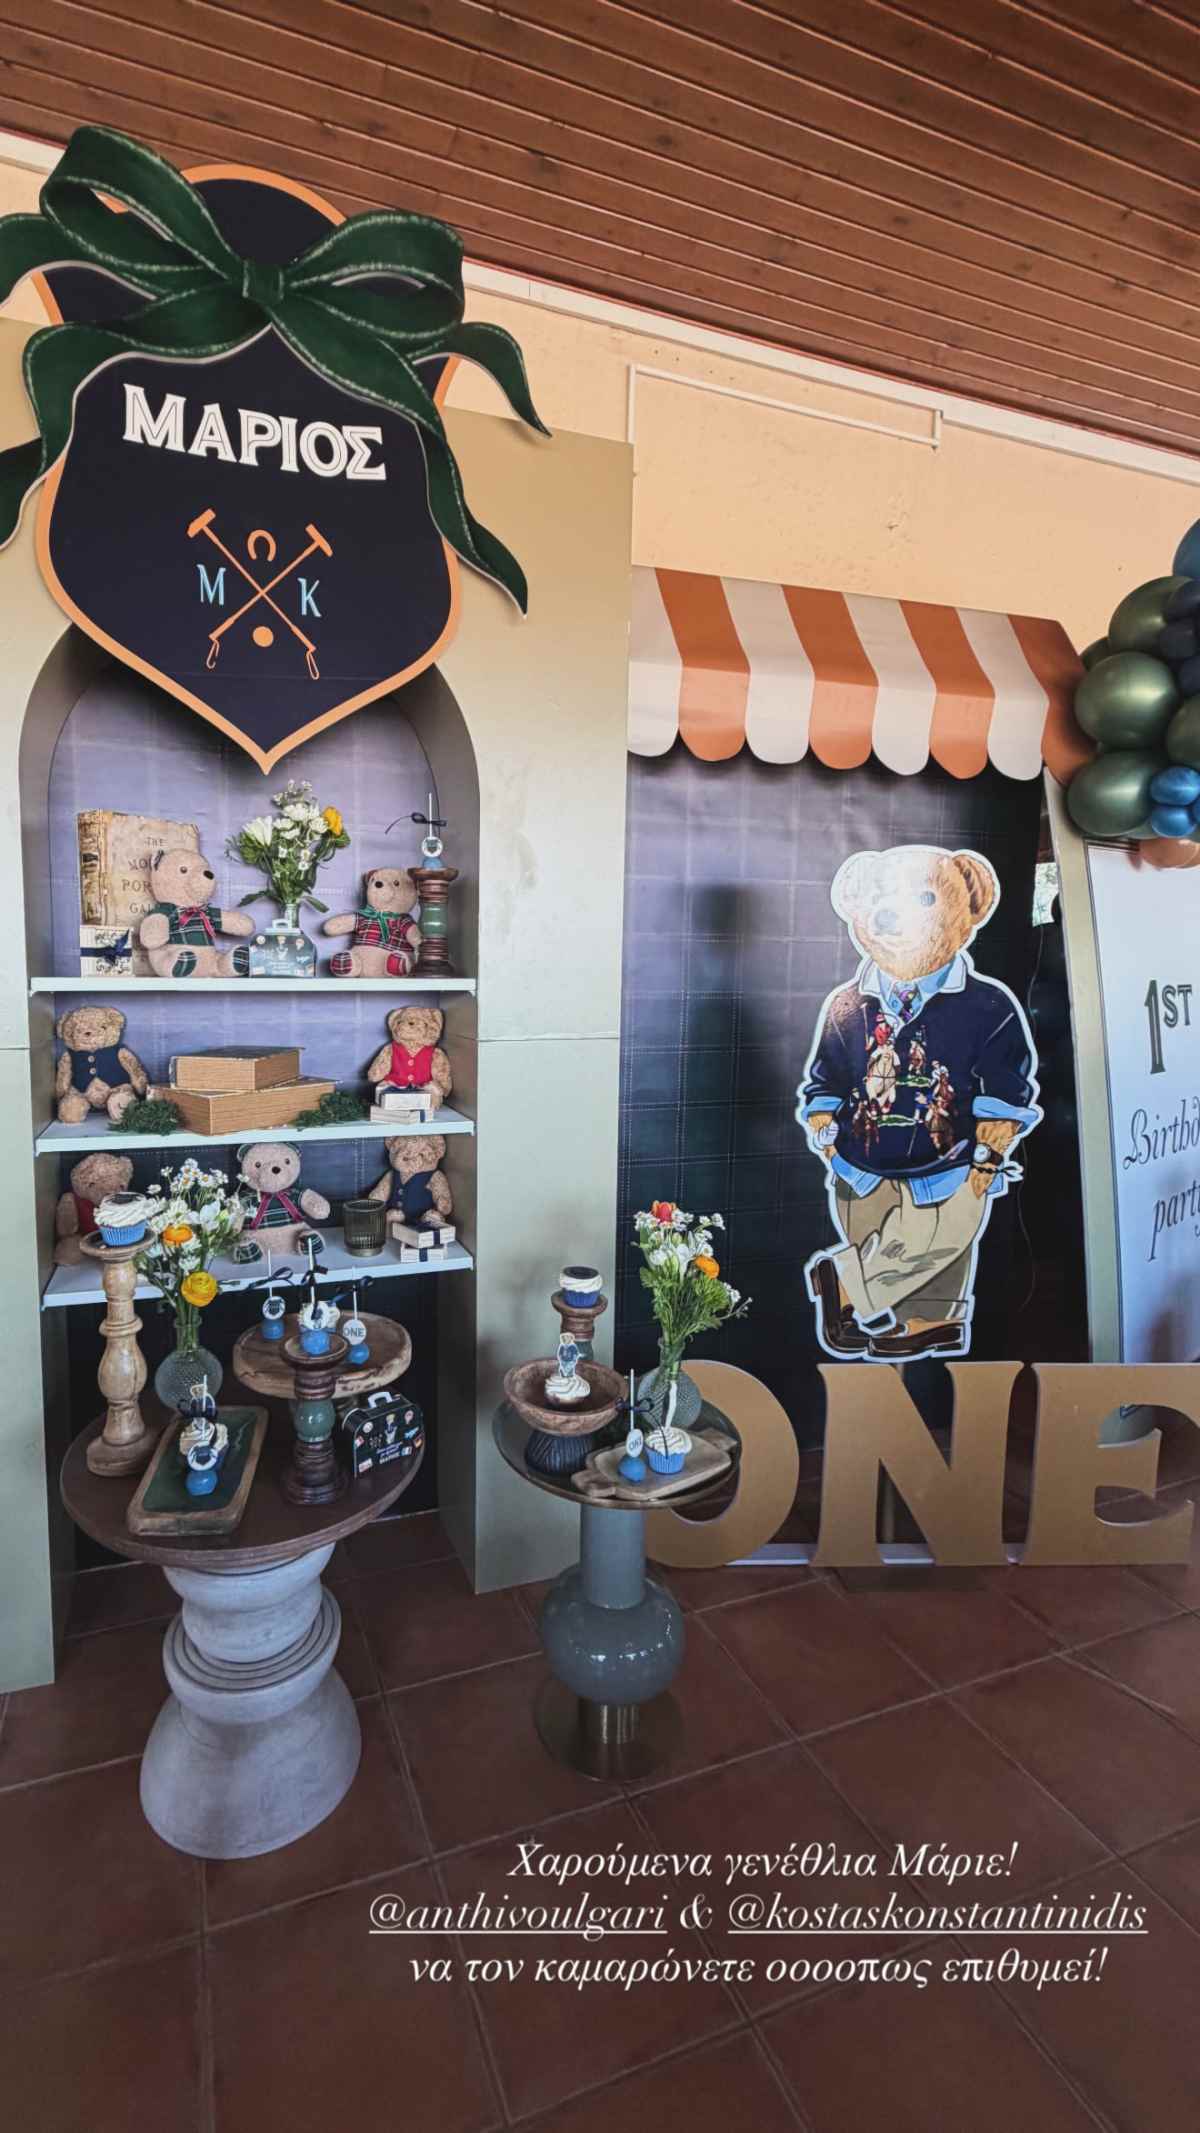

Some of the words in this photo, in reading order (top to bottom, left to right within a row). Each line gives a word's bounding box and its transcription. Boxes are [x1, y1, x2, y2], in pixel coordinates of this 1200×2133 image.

[122, 382, 387, 481] ΜΑΡΙΟΣ
[1144, 979, 1192, 1075] 1ST
[645, 1360, 1200, 1568] ONE
